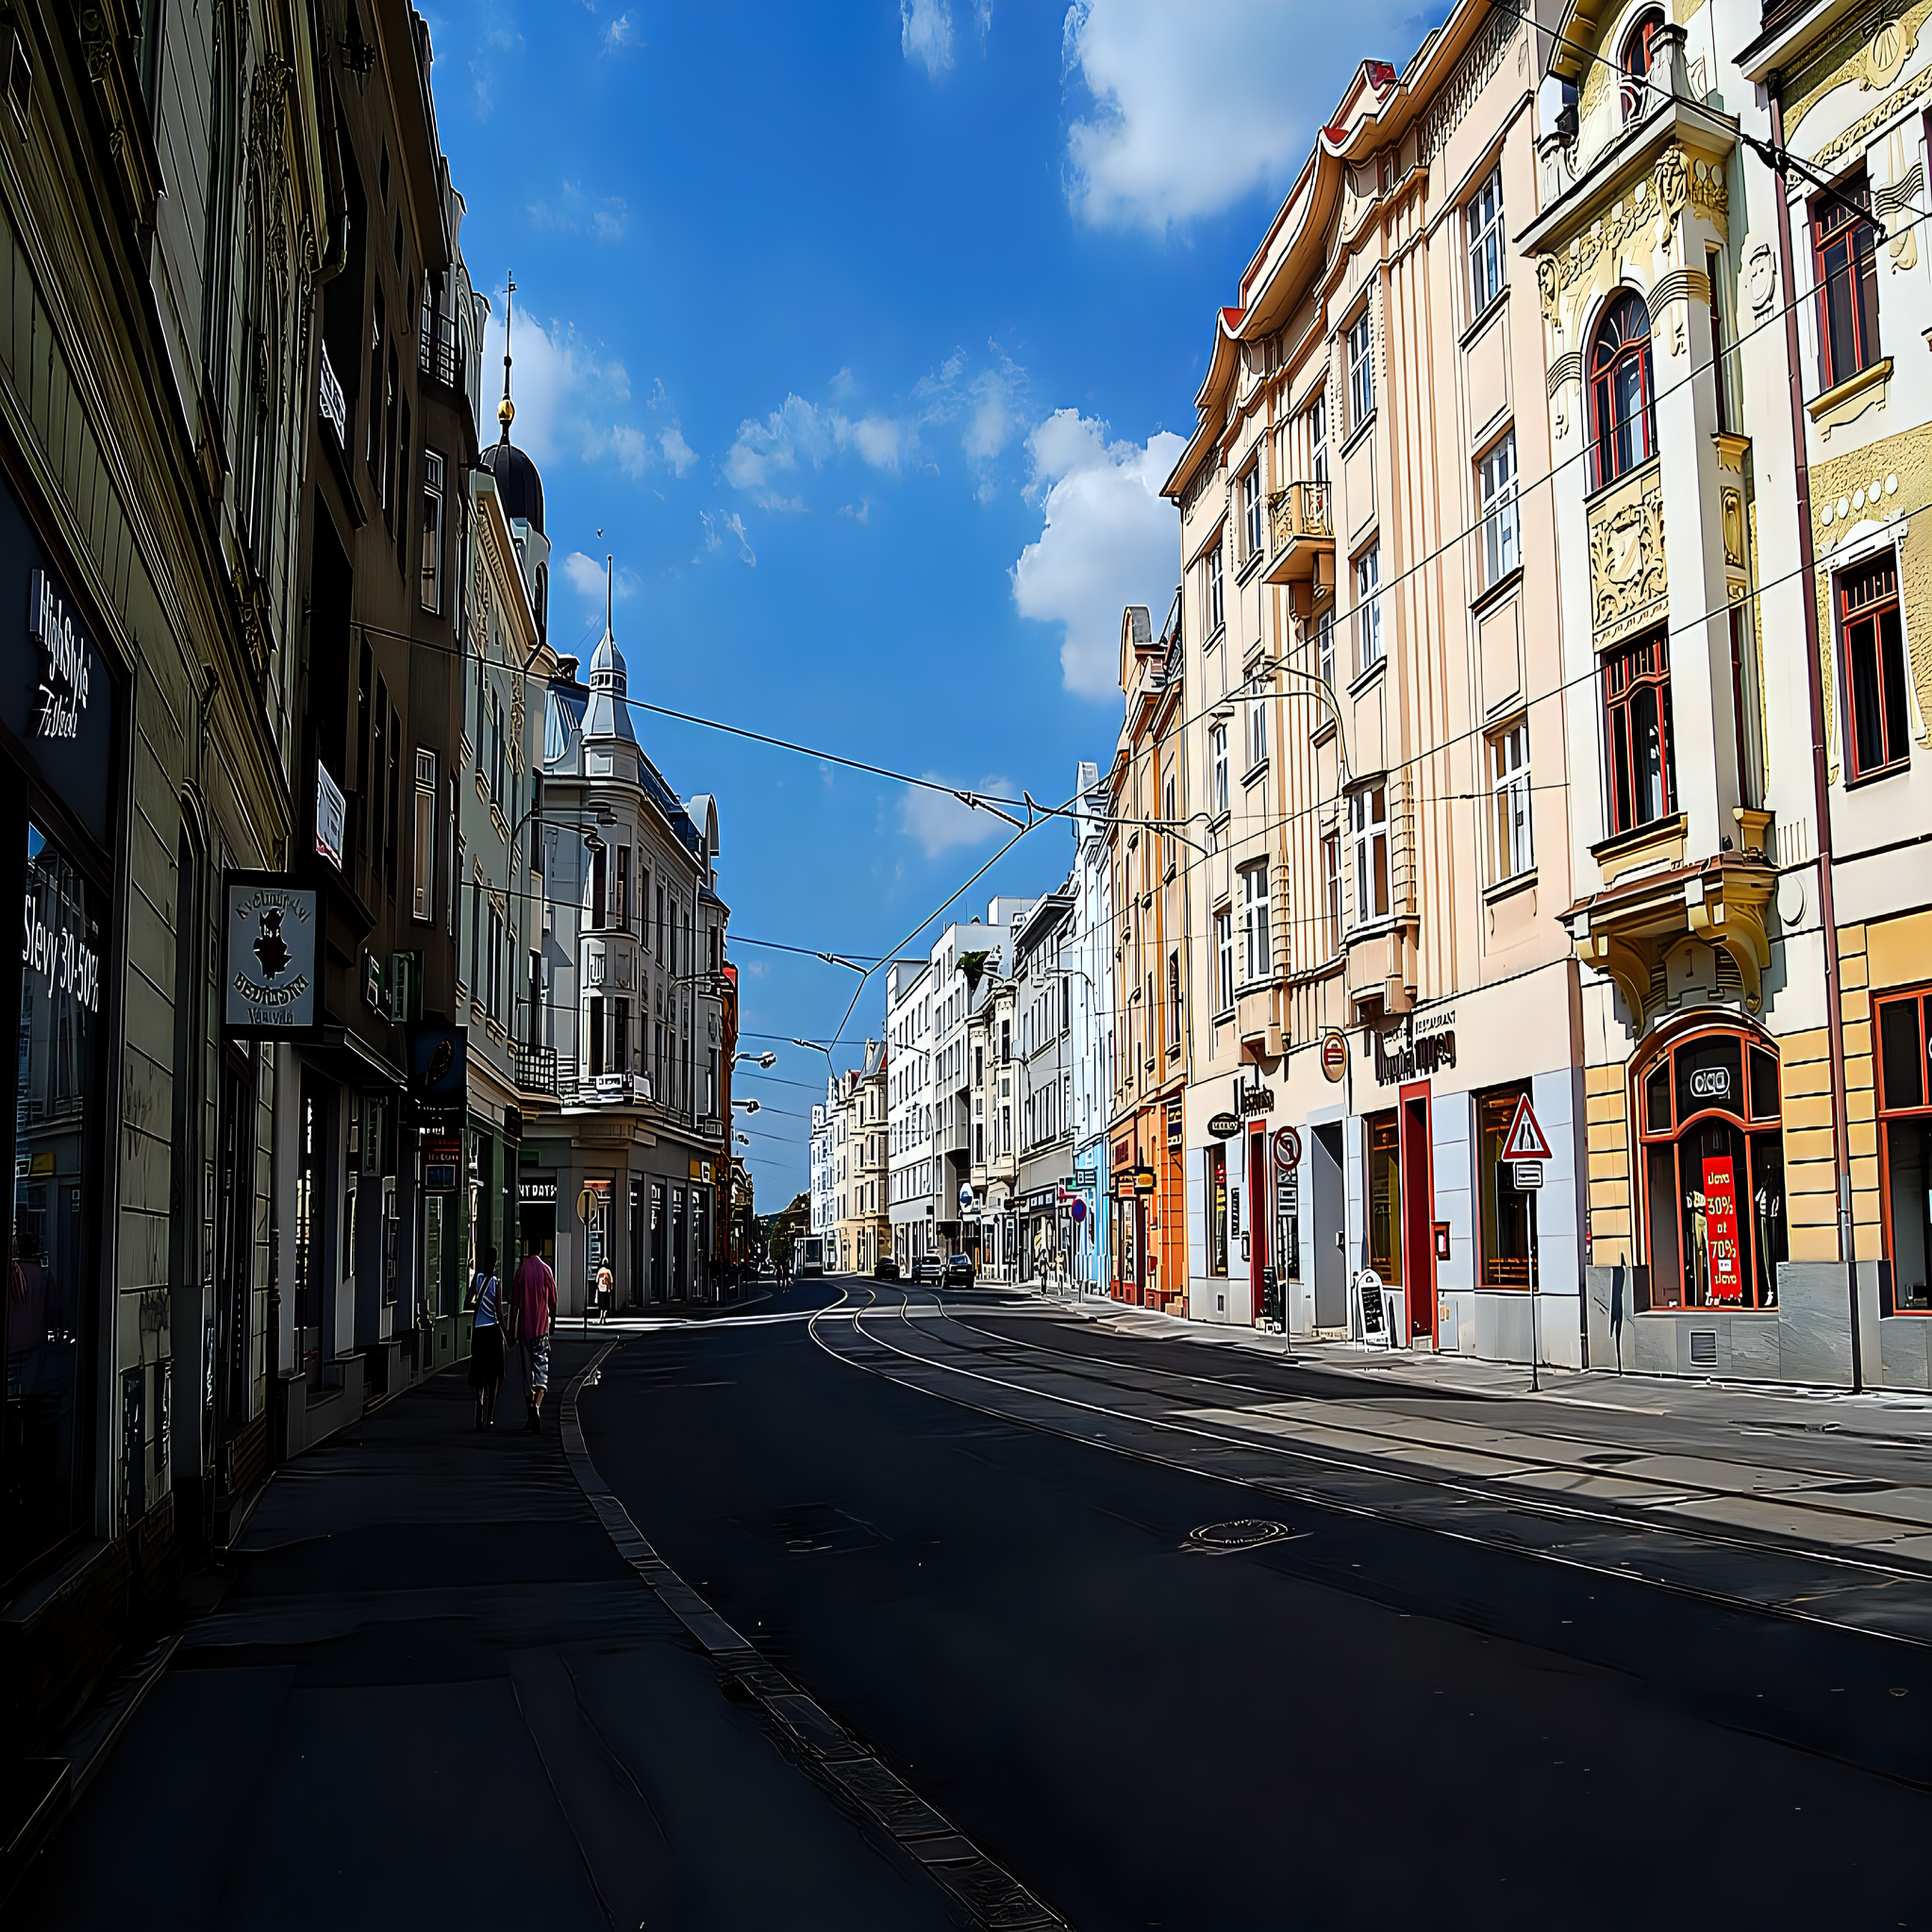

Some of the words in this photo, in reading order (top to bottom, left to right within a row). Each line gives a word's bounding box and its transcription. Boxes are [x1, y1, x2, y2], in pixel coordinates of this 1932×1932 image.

[23, 893, 58, 999] Slevy
[1707, 1195, 1733, 1215] 30%
[1709, 1239, 1736, 1258] 70%
